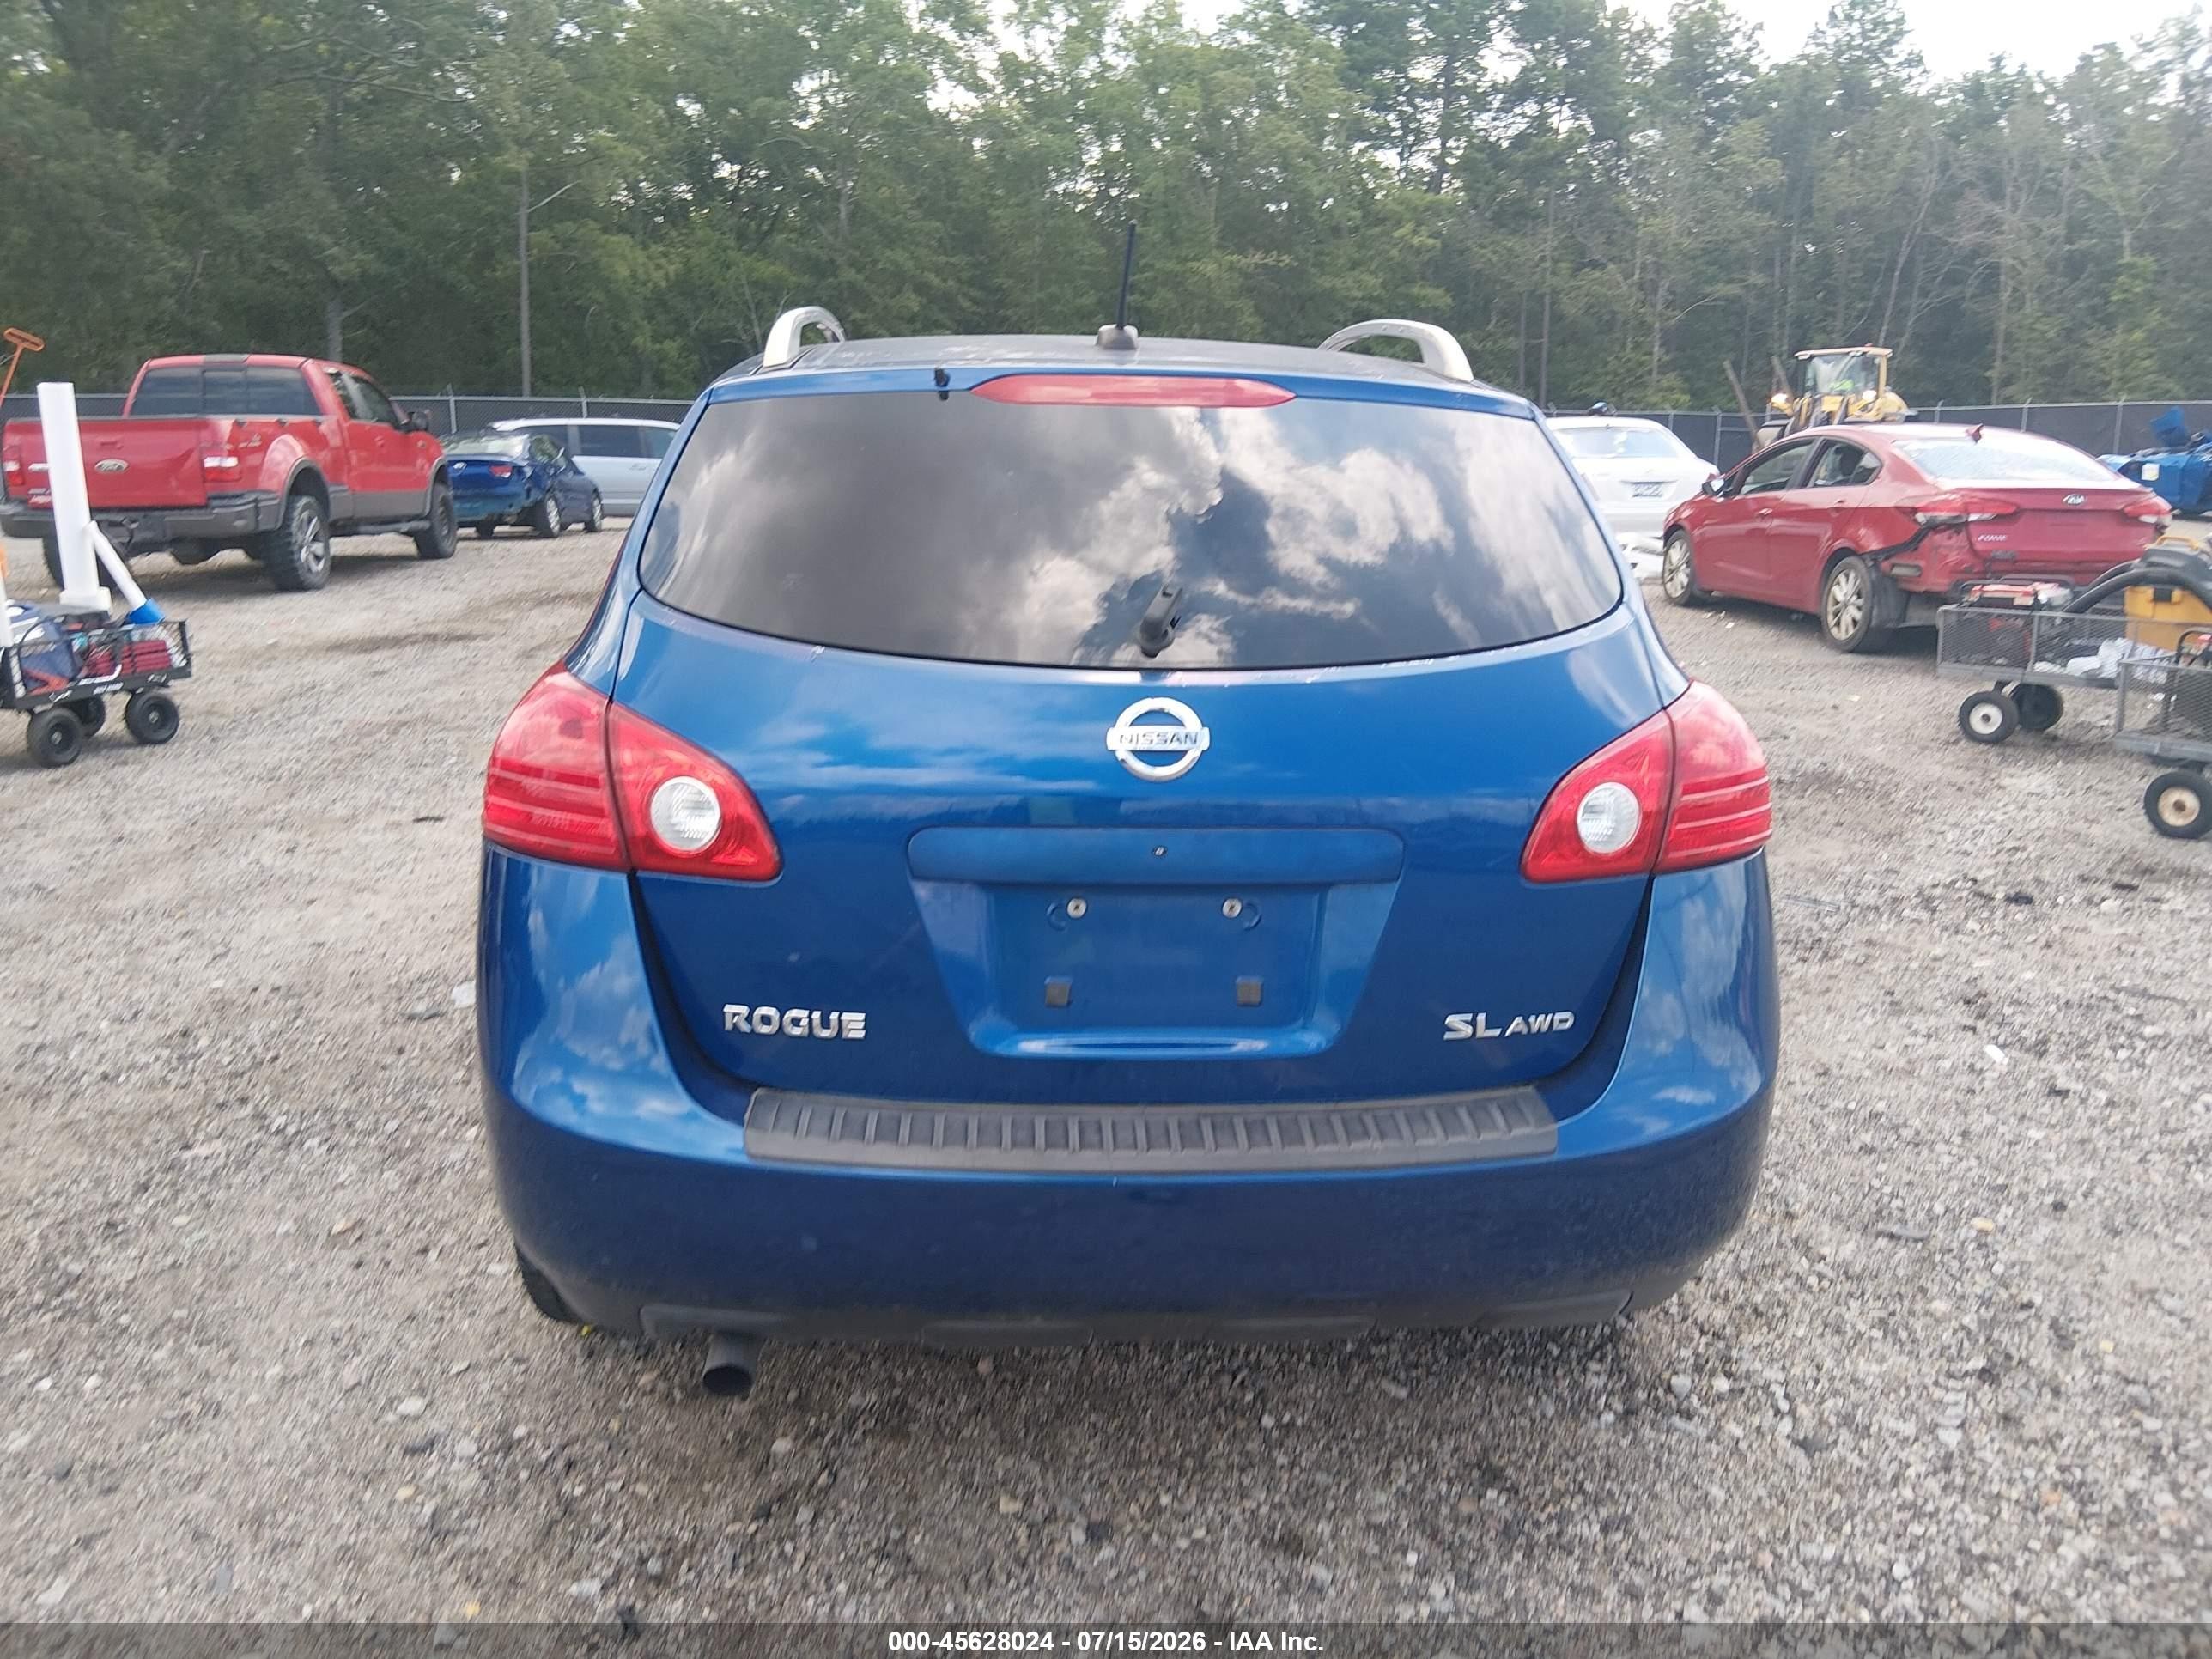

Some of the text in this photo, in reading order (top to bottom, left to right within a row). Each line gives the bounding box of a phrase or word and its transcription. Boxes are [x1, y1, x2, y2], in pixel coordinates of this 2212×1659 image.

[1119, 732, 1199, 745] NISSAN
[723, 1004, 866, 1039] ROGUE
[1443, 1012, 1575, 1040] SL AWD
